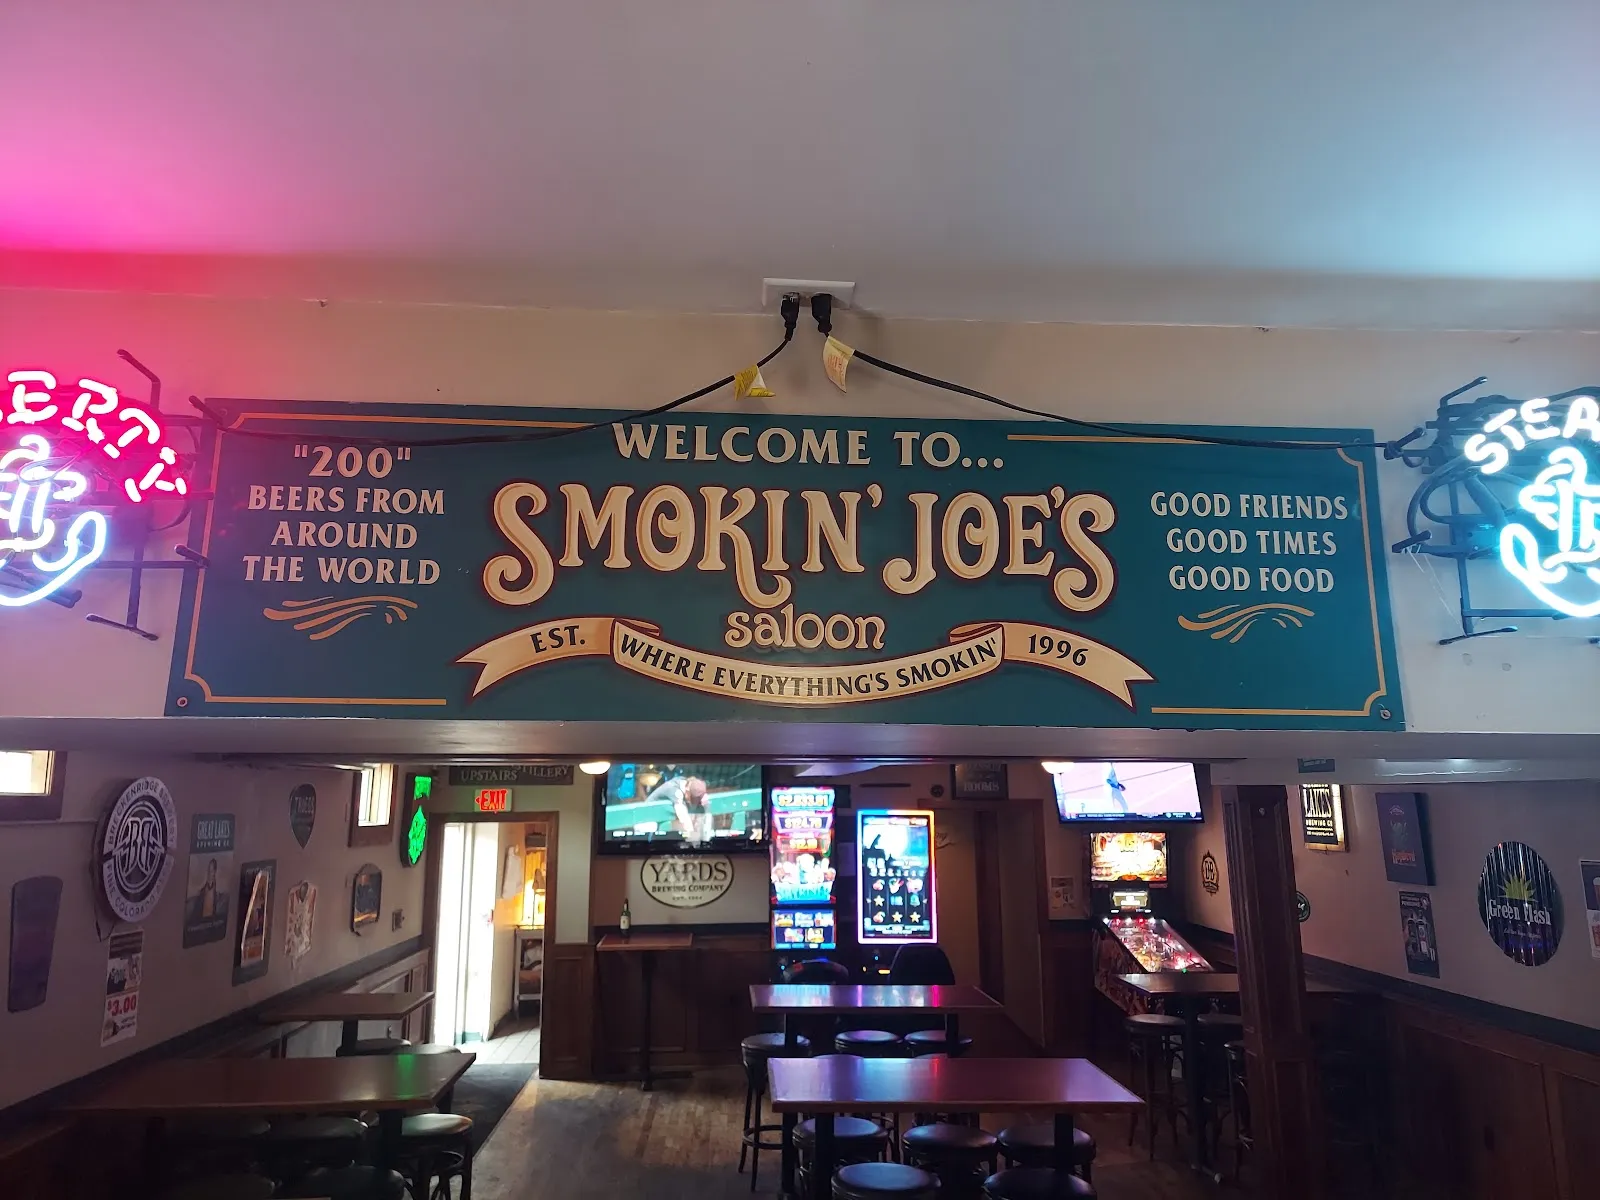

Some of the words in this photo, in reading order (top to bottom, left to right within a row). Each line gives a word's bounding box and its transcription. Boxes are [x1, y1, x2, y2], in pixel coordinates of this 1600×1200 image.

[0, 370, 188, 502] ERTY
[612, 423, 871, 465] WELCOME
[893, 431, 1004, 468] TO...
[294, 445, 412, 478] "200"
[247, 485, 345, 513] BEERS
[355, 487, 445, 515] FROM
[1150, 491, 1231, 518] GOOD
[1239, 494, 1348, 520] FRIENDS
[271, 521, 418, 549] AROUND
[483, 482, 882, 609] SMOKIN'
[882, 486, 1115, 612] JOE'S
[1166, 528, 1247, 554] GOOD
[1256, 530, 1337, 556] TIMES
[243, 555, 304, 582] THE
[318, 557, 440, 585] WORLD
[1169, 565, 1250, 592] GOOD
[1259, 567, 1335, 593] FOOD
[530, 625, 586, 653] EST.
[724, 603, 885, 650] saloon
[1028, 633, 1089, 667] 1996
[620, 634, 706, 682] WHERE
[713, 666, 889, 697] EVERYTHING'S
[897, 637, 997, 688] SMOKIN'
[461, 770, 518, 782] UPSTAIRS
[480, 788, 508, 811] EXIT
[1303, 788, 1332, 818] LAKES
[650, 861, 728, 883] YARDS
[651, 884, 686, 893] BREWING
[688, 884, 725, 893] COMPANY
[1488, 899, 1521, 920] Green
